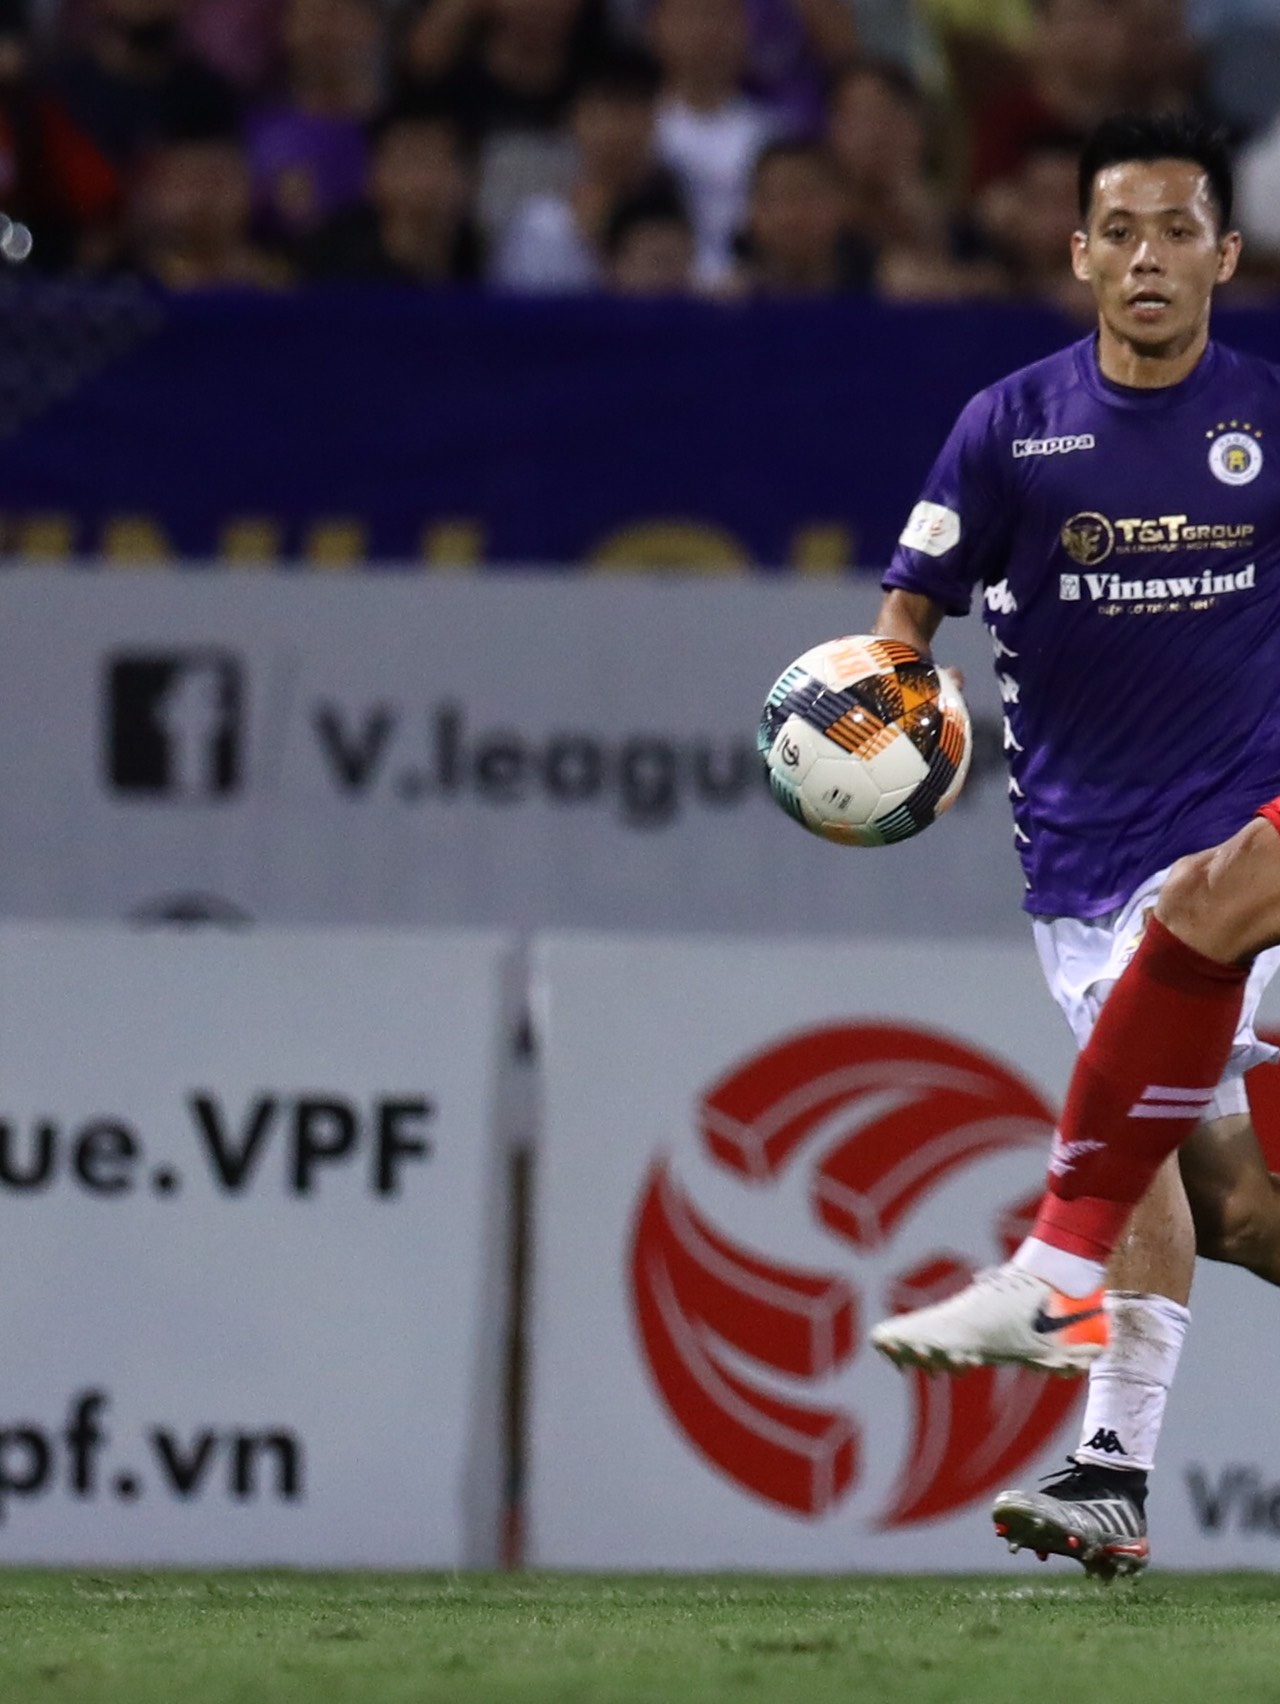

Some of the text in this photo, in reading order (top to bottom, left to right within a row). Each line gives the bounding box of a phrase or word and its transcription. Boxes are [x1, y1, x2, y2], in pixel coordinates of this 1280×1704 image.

[1012, 433, 1096, 458] Kappa
[1182, 525, 1255, 541] GROUP
[1085, 563, 1257, 601] Vinawind
